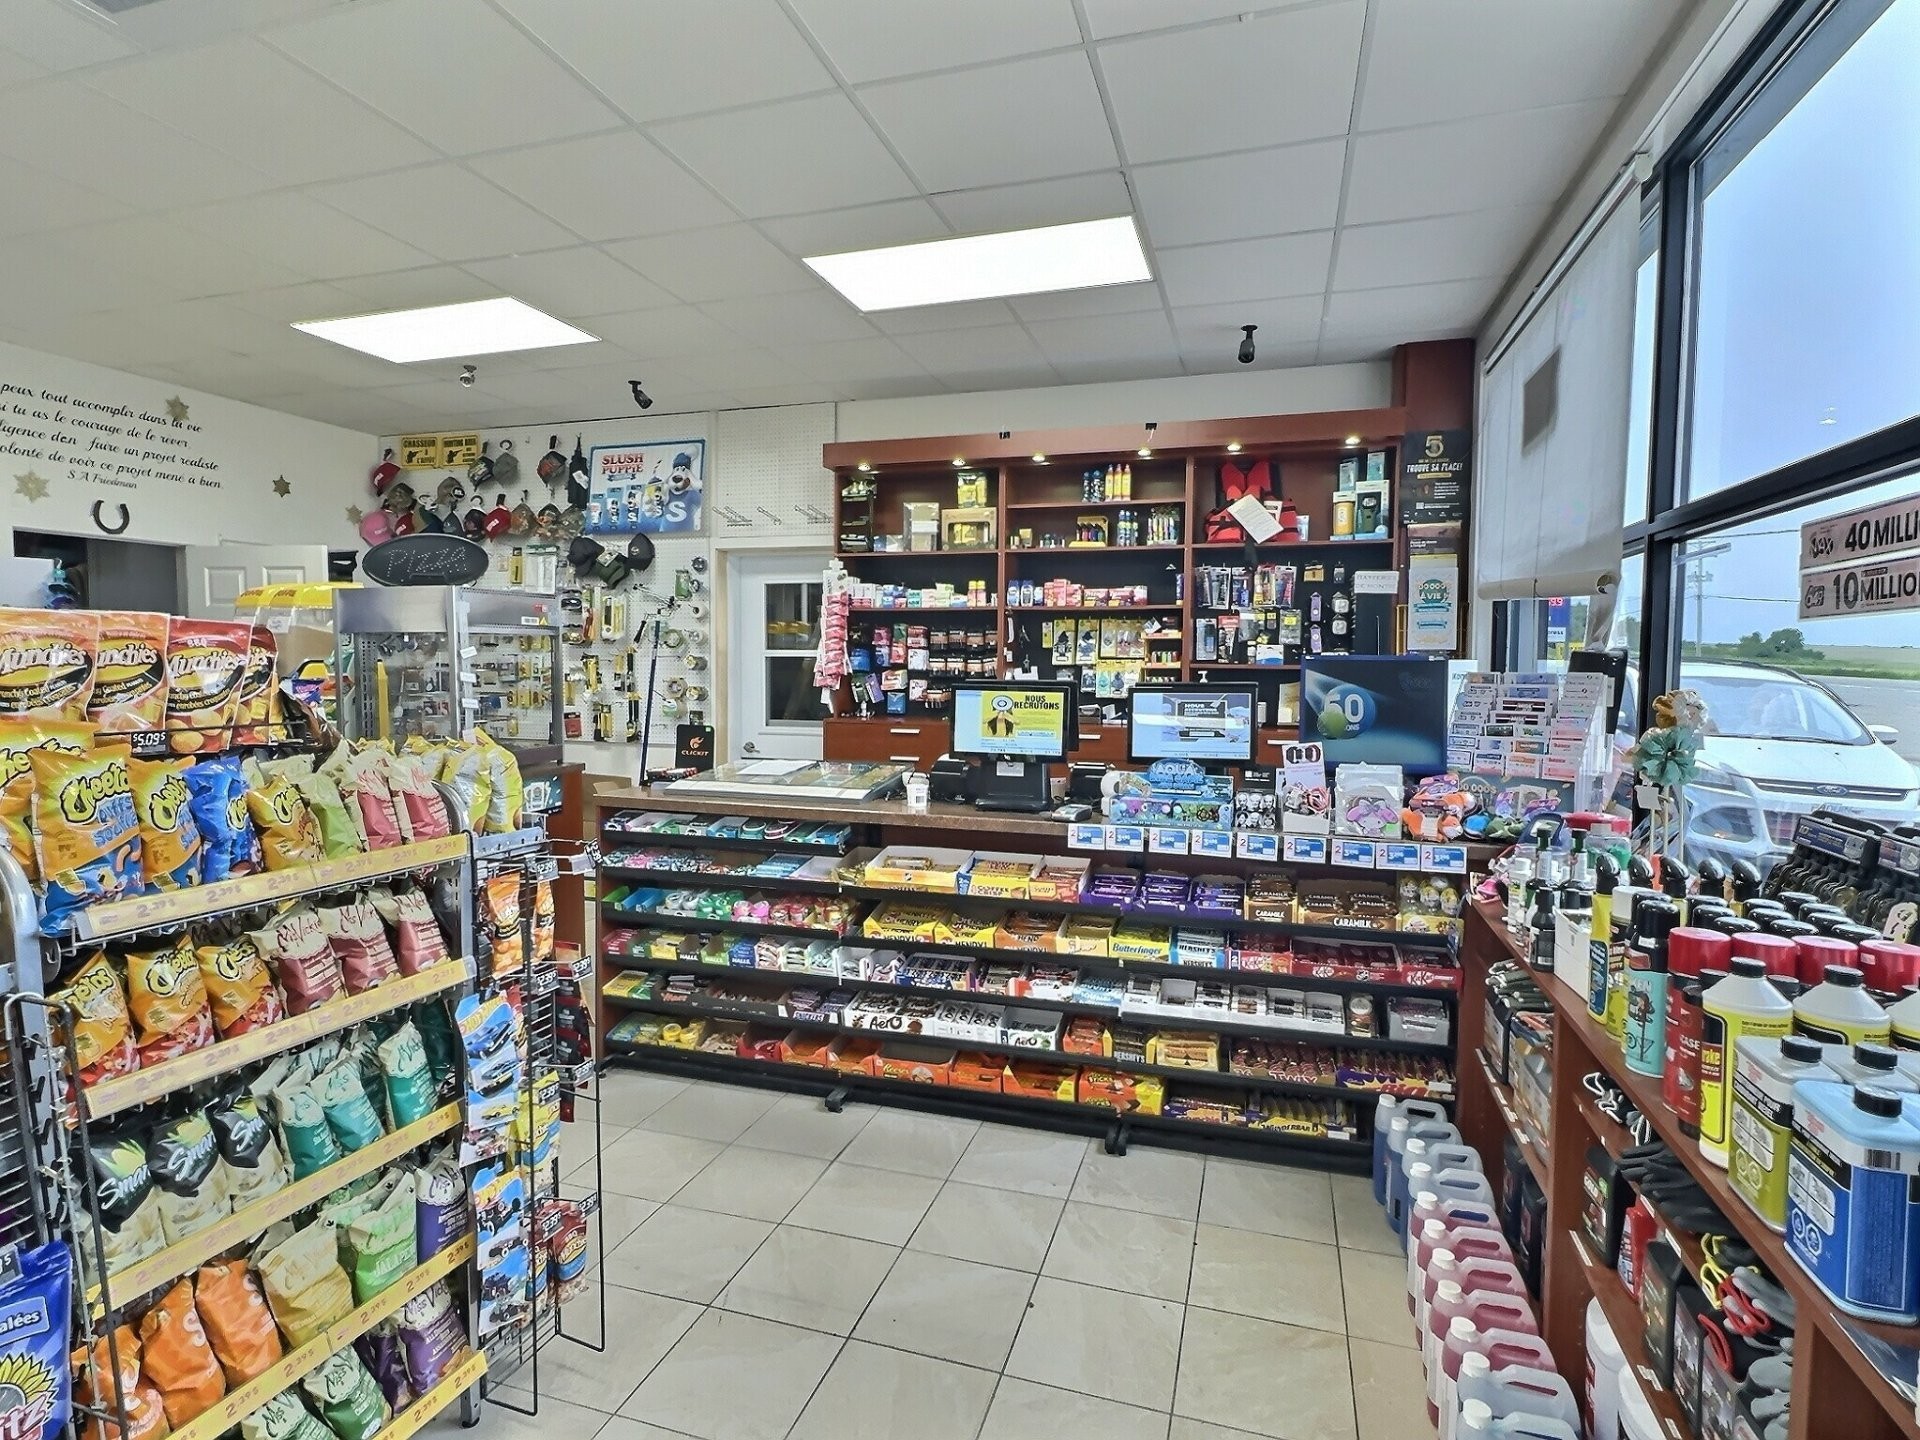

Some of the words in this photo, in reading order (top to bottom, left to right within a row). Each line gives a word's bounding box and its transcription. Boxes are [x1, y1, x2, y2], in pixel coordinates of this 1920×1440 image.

[1, 383, 34, 397] peux
[41, 389, 68, 405] tout
[72, 398, 135, 419] accomplir
[138, 409, 167, 426] dans
[187, 423, 203, 434] vie
[13, 404, 27, 416] tu
[32, 410, 49, 421] as
[54, 409, 67, 423] le
[71, 418, 123, 436] courage
[127, 426, 142, 438] de
[146, 430, 156, 442] le
[88, 438, 120, 453] faire
[124, 446, 139, 457] un
[141, 450, 176, 464] projet
[48, 448, 65, 462] de
[69, 455, 96, 469] voir
[100, 461, 114, 472] ce
[116, 463, 152, 479] projet
[602, 453, 644, 467] SLUSH
[602, 464, 644, 475] PUPPIE
[92, 473, 138, 489] Friedman
[1845, 519, 1871, 552] 40
[1833, 571, 1859, 610] 10
[1025, 694, 1046, 702] NOUS
[1014, 701, 1060, 710] RECRUTONS
[1158, 764, 1195, 774] AQUA
[1256, 910, 1285, 918] CARAMILK
[1334, 918, 1372, 929] CARAMILK
[1112, 943, 1162, 955] Butterfinger
